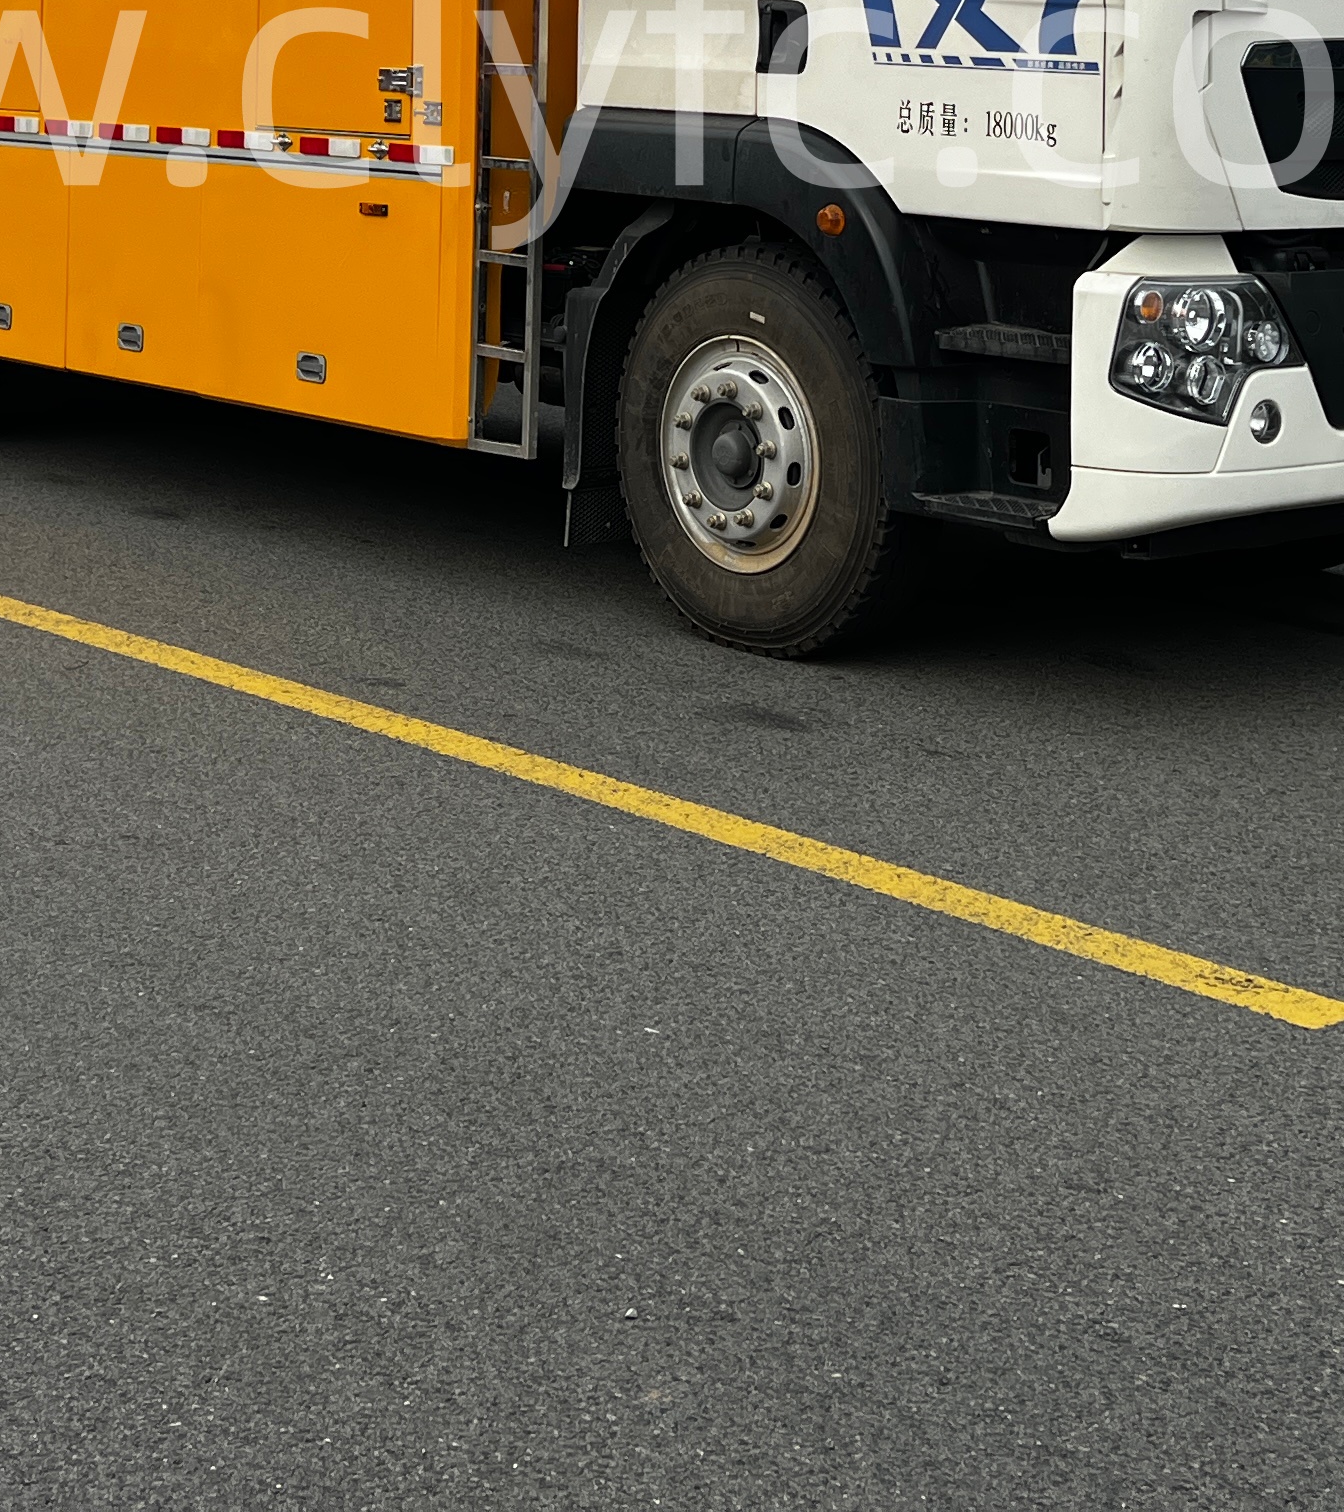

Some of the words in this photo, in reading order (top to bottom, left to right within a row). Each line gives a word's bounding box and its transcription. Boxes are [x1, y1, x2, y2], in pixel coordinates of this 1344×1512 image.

[896, 99, 969, 138] 总质量：
[985, 109, 1057, 148] 18000kg
